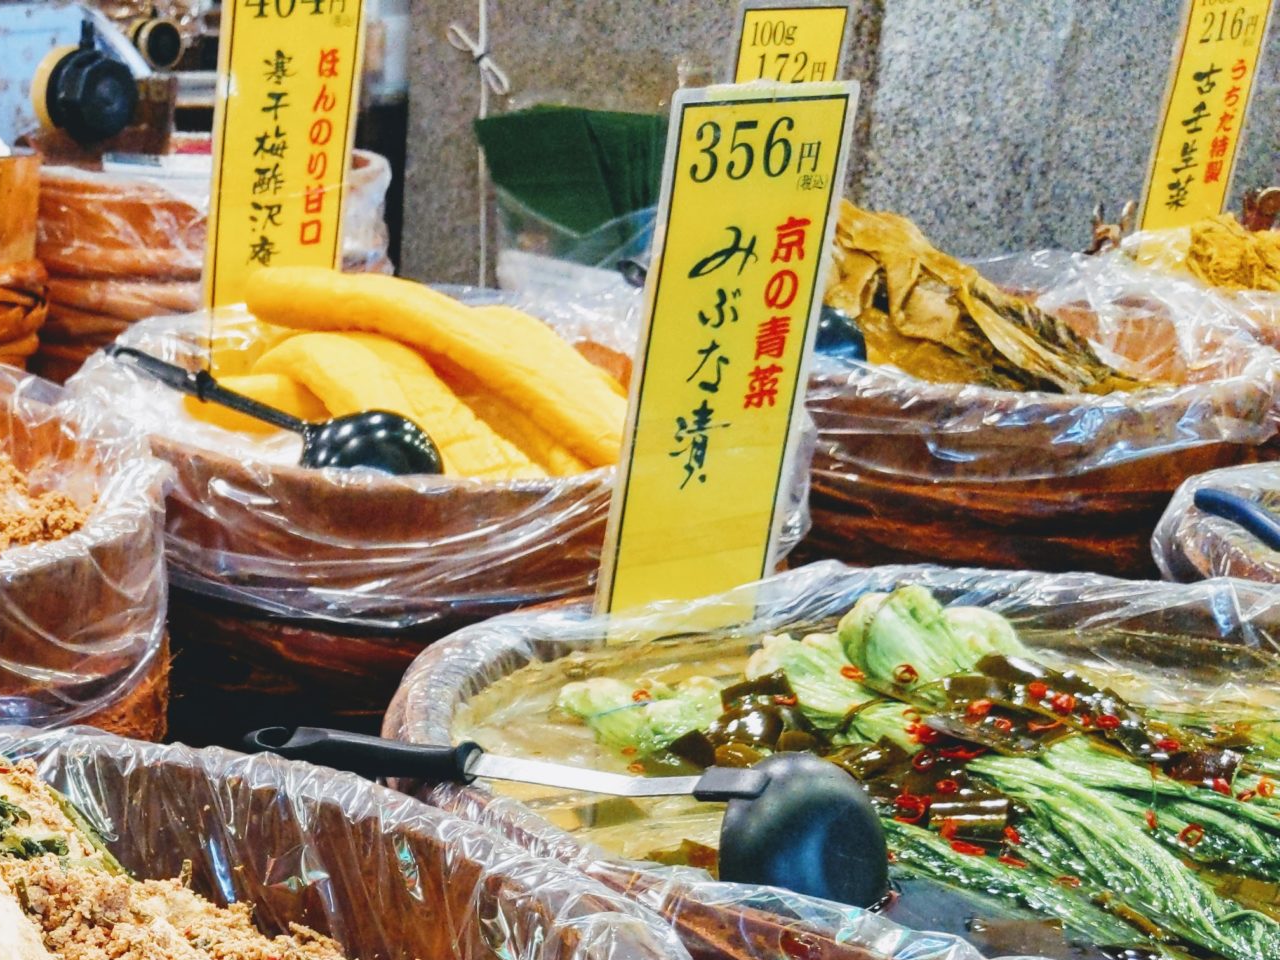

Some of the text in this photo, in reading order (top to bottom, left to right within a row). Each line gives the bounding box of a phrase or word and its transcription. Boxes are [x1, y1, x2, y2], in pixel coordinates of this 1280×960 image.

[751, 20, 798, 47] 100g
[757, 51, 827, 83] 172円
[1198, 7, 1260, 44] 216円
[299, 48, 340, 246] ほんのり甘口
[689, 116, 822, 183] 356円
[1203, 59, 1247, 184] うちだ特製
[669, 225, 758, 490] みぶな漬
[742, 216, 812, 410] 京の青菜
